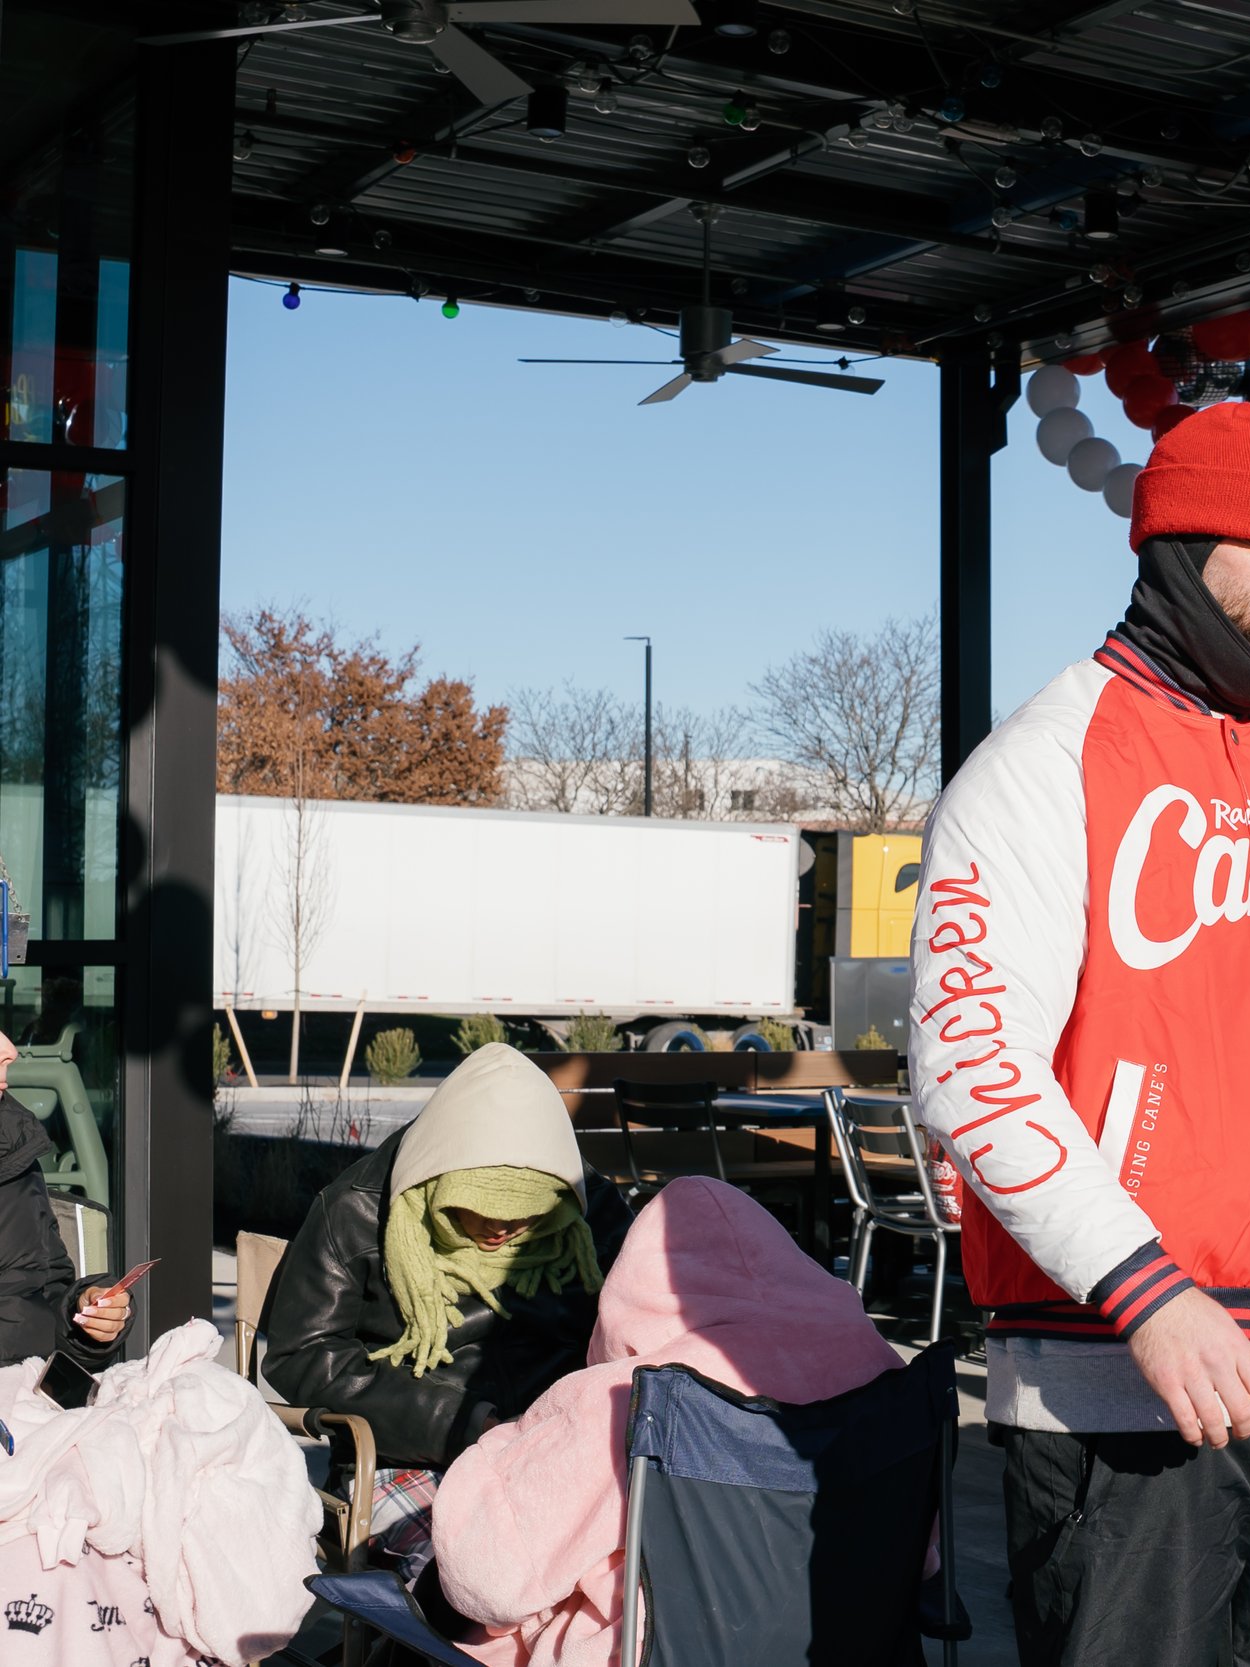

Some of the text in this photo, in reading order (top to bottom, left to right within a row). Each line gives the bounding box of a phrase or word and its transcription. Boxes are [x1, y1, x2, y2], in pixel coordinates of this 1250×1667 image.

[920, 861, 1068, 1195] Chicken
[1126, 1063, 1168, 1199] ISING CANE'S
